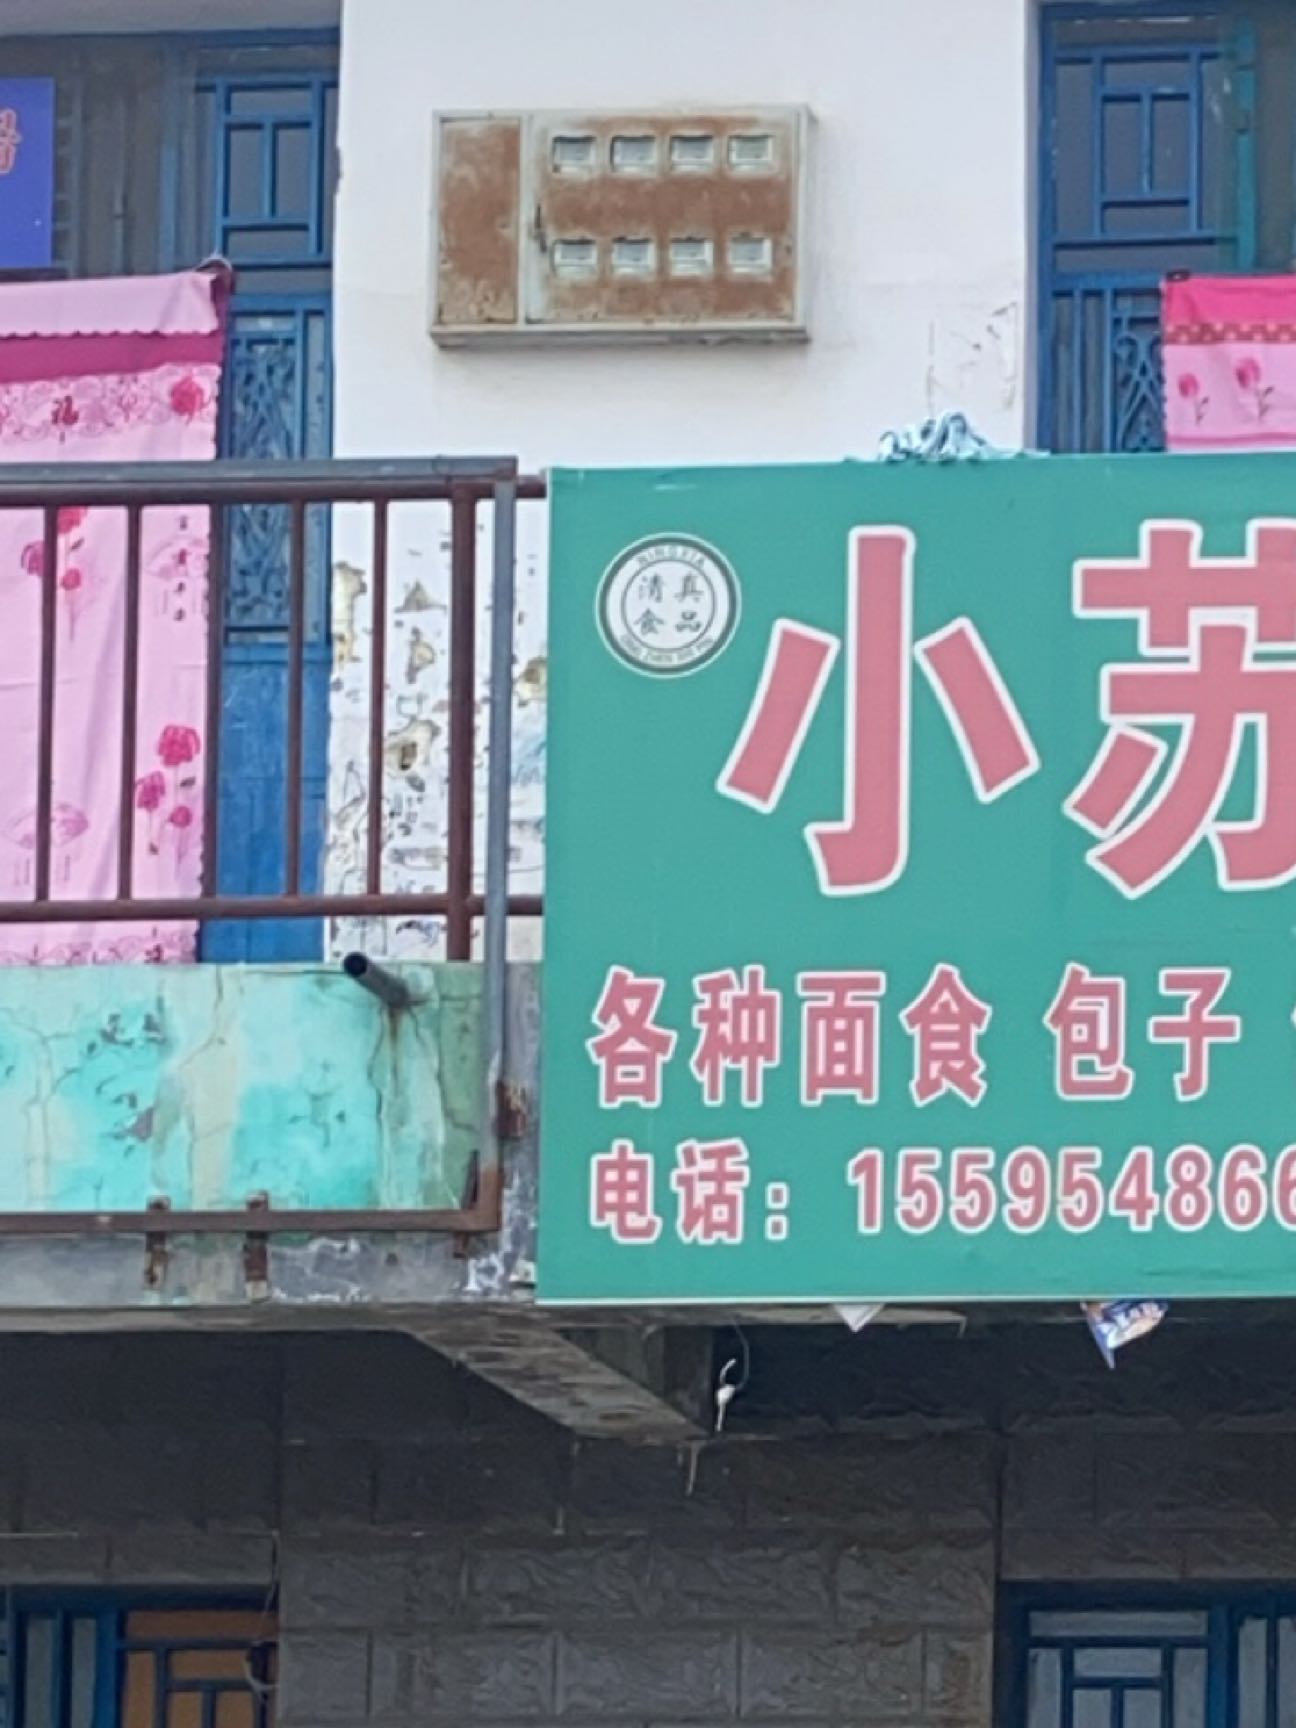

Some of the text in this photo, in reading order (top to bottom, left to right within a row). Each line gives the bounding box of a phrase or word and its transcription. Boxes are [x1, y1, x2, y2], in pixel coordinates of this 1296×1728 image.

[638, 572, 705, 603] 清真
[634, 608, 703, 635] 食品
[592, 965, 988, 1104] 各种面食
[1047, 965, 1238, 1098] 包子
